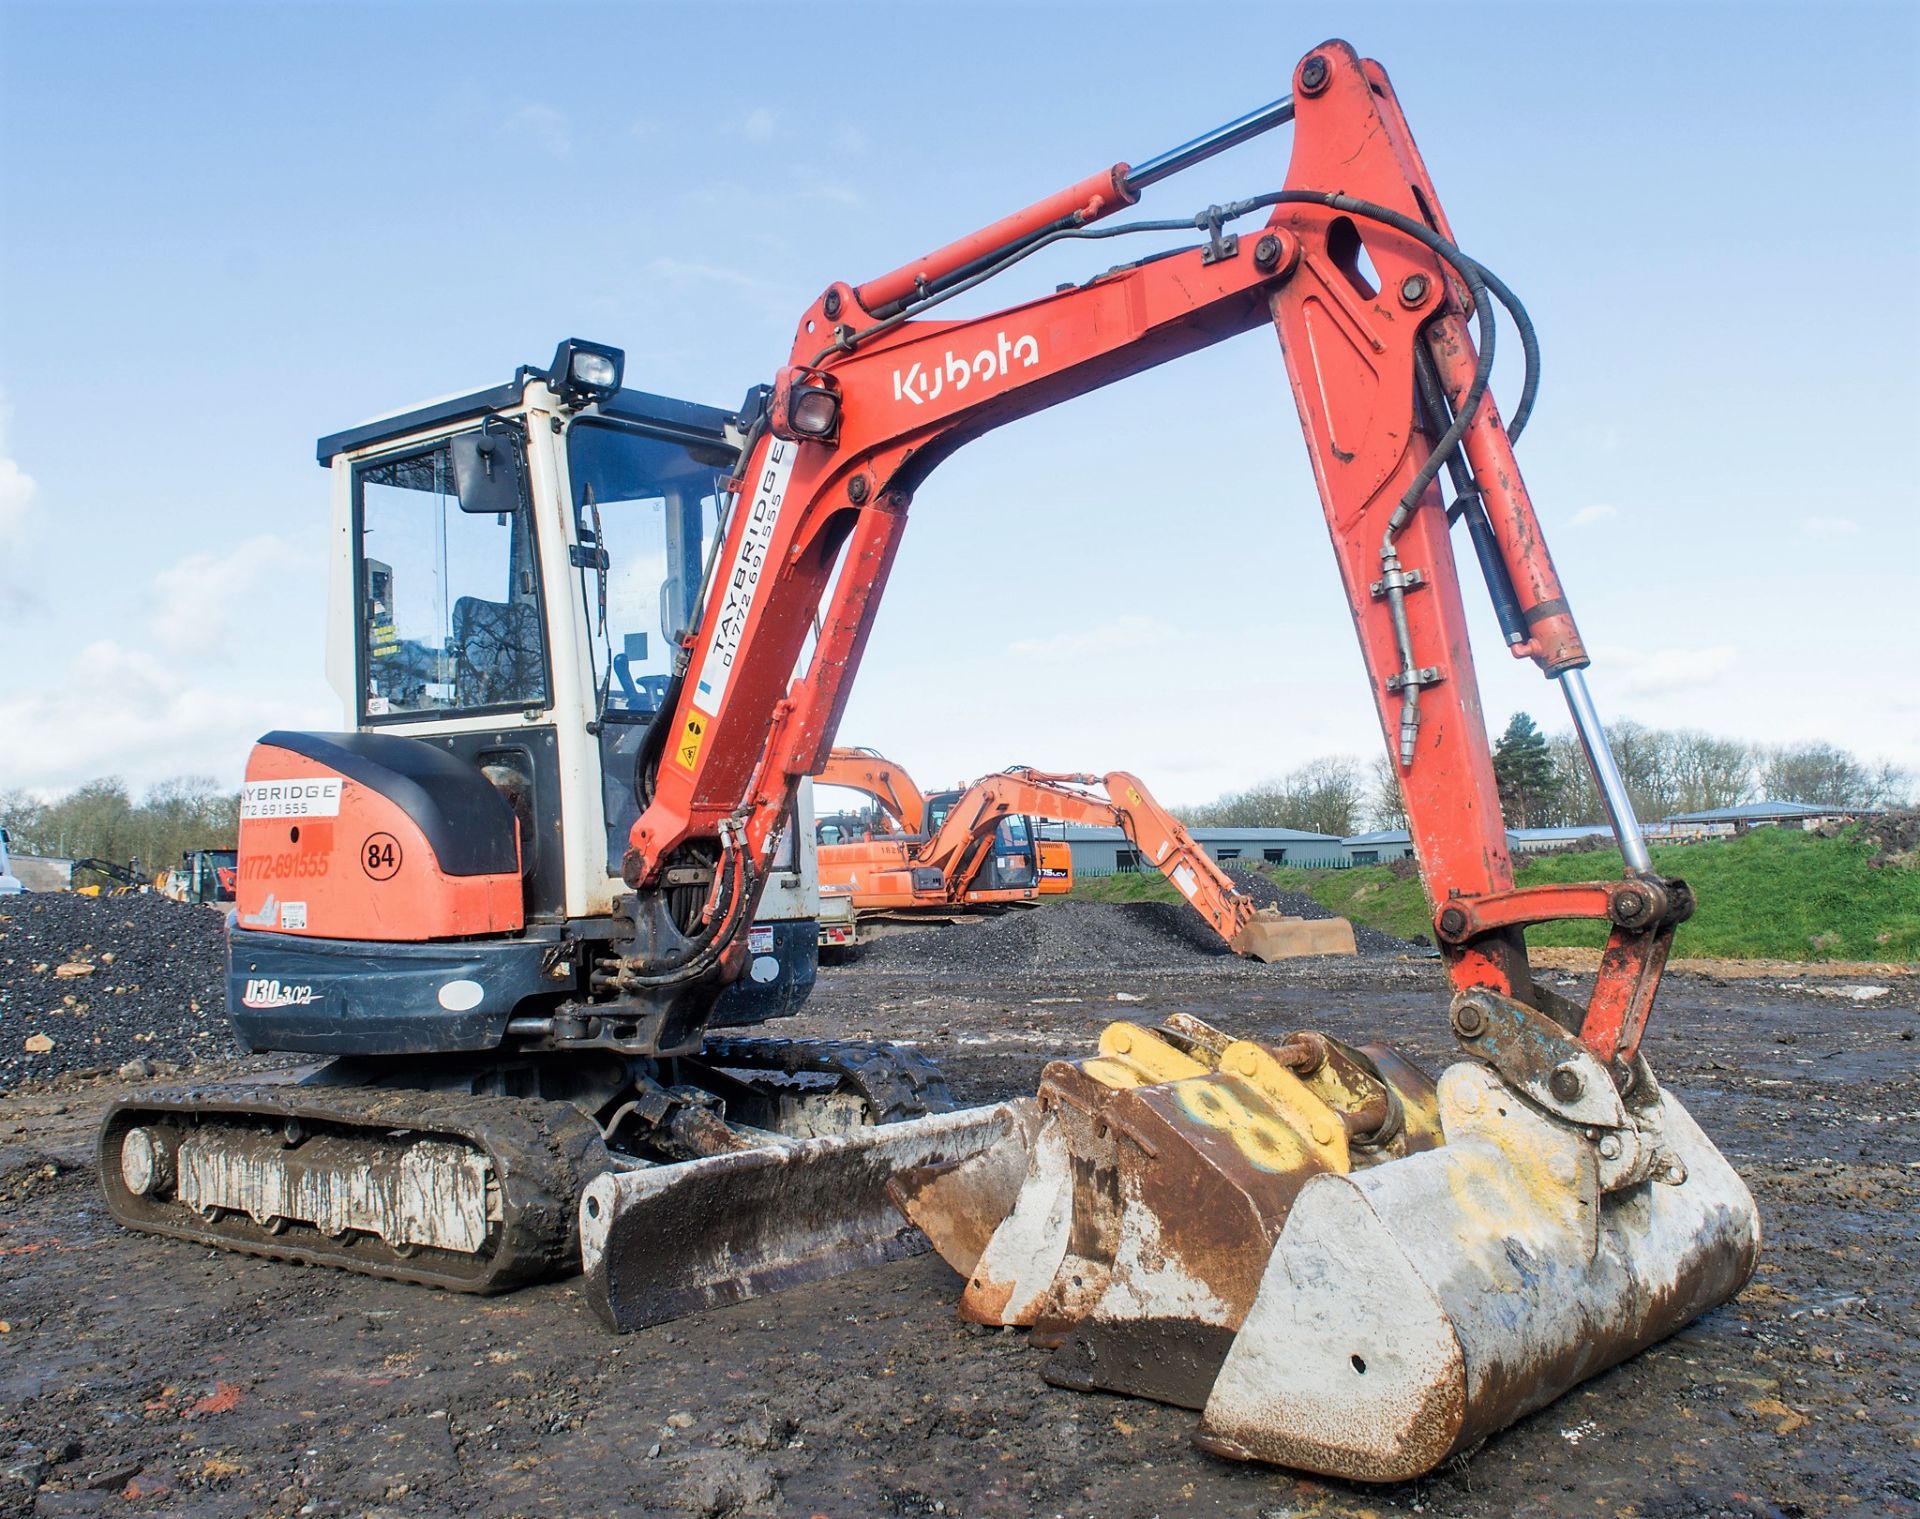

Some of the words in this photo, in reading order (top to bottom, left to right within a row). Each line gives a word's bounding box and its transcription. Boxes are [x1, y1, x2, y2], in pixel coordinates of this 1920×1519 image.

[892, 331, 1040, 405] Kubota
[712, 443, 786, 655] TAYBRIDGE
[722, 595, 751, 668] 01772
[748, 493, 782, 585] 691555
[261, 802, 309, 815] 691555
[368, 843, 395, 869] 84
